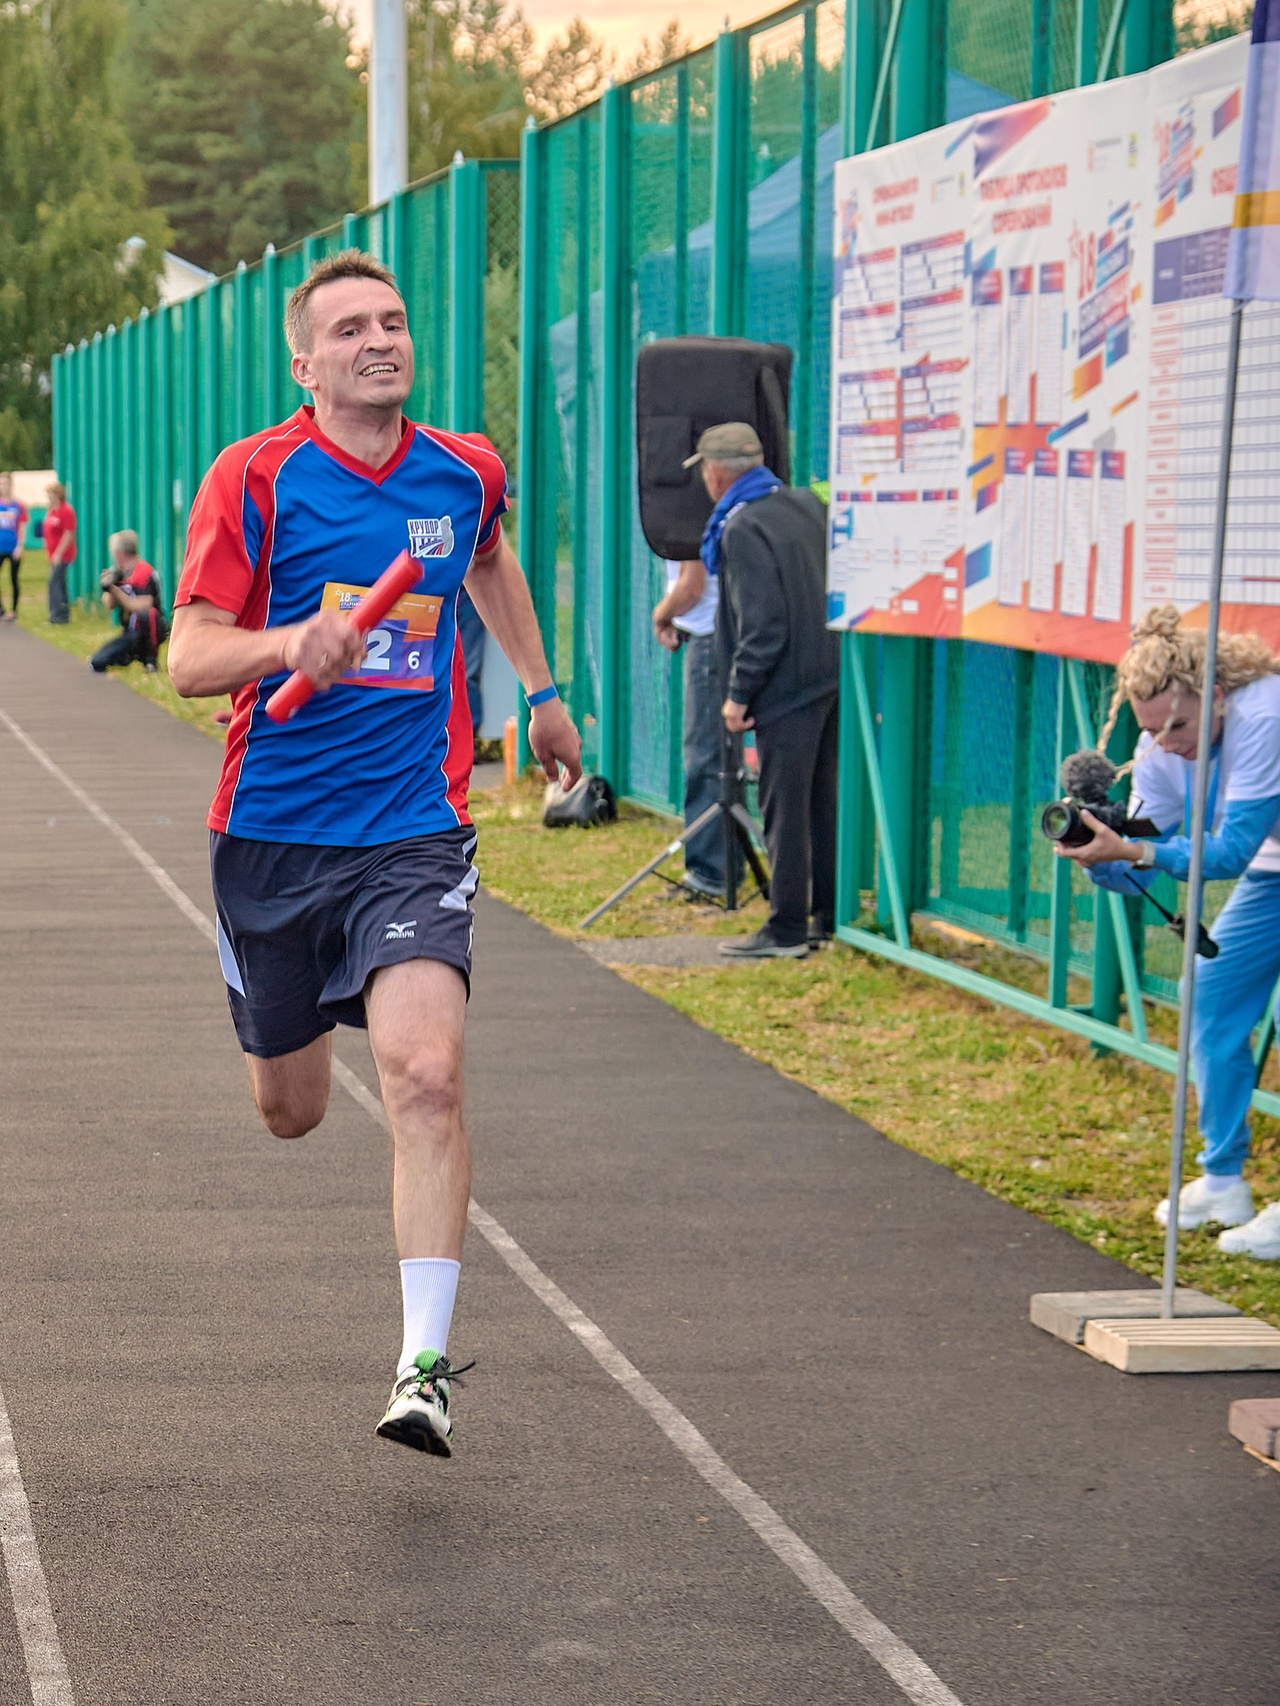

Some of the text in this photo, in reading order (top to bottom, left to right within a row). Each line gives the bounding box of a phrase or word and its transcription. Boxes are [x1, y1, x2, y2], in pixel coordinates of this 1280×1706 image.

[408, 520, 439, 535] КРУДОР
[339, 592, 351, 602] 18
[361, 628, 392, 671] 2
[407, 651, 420, 670] 6
